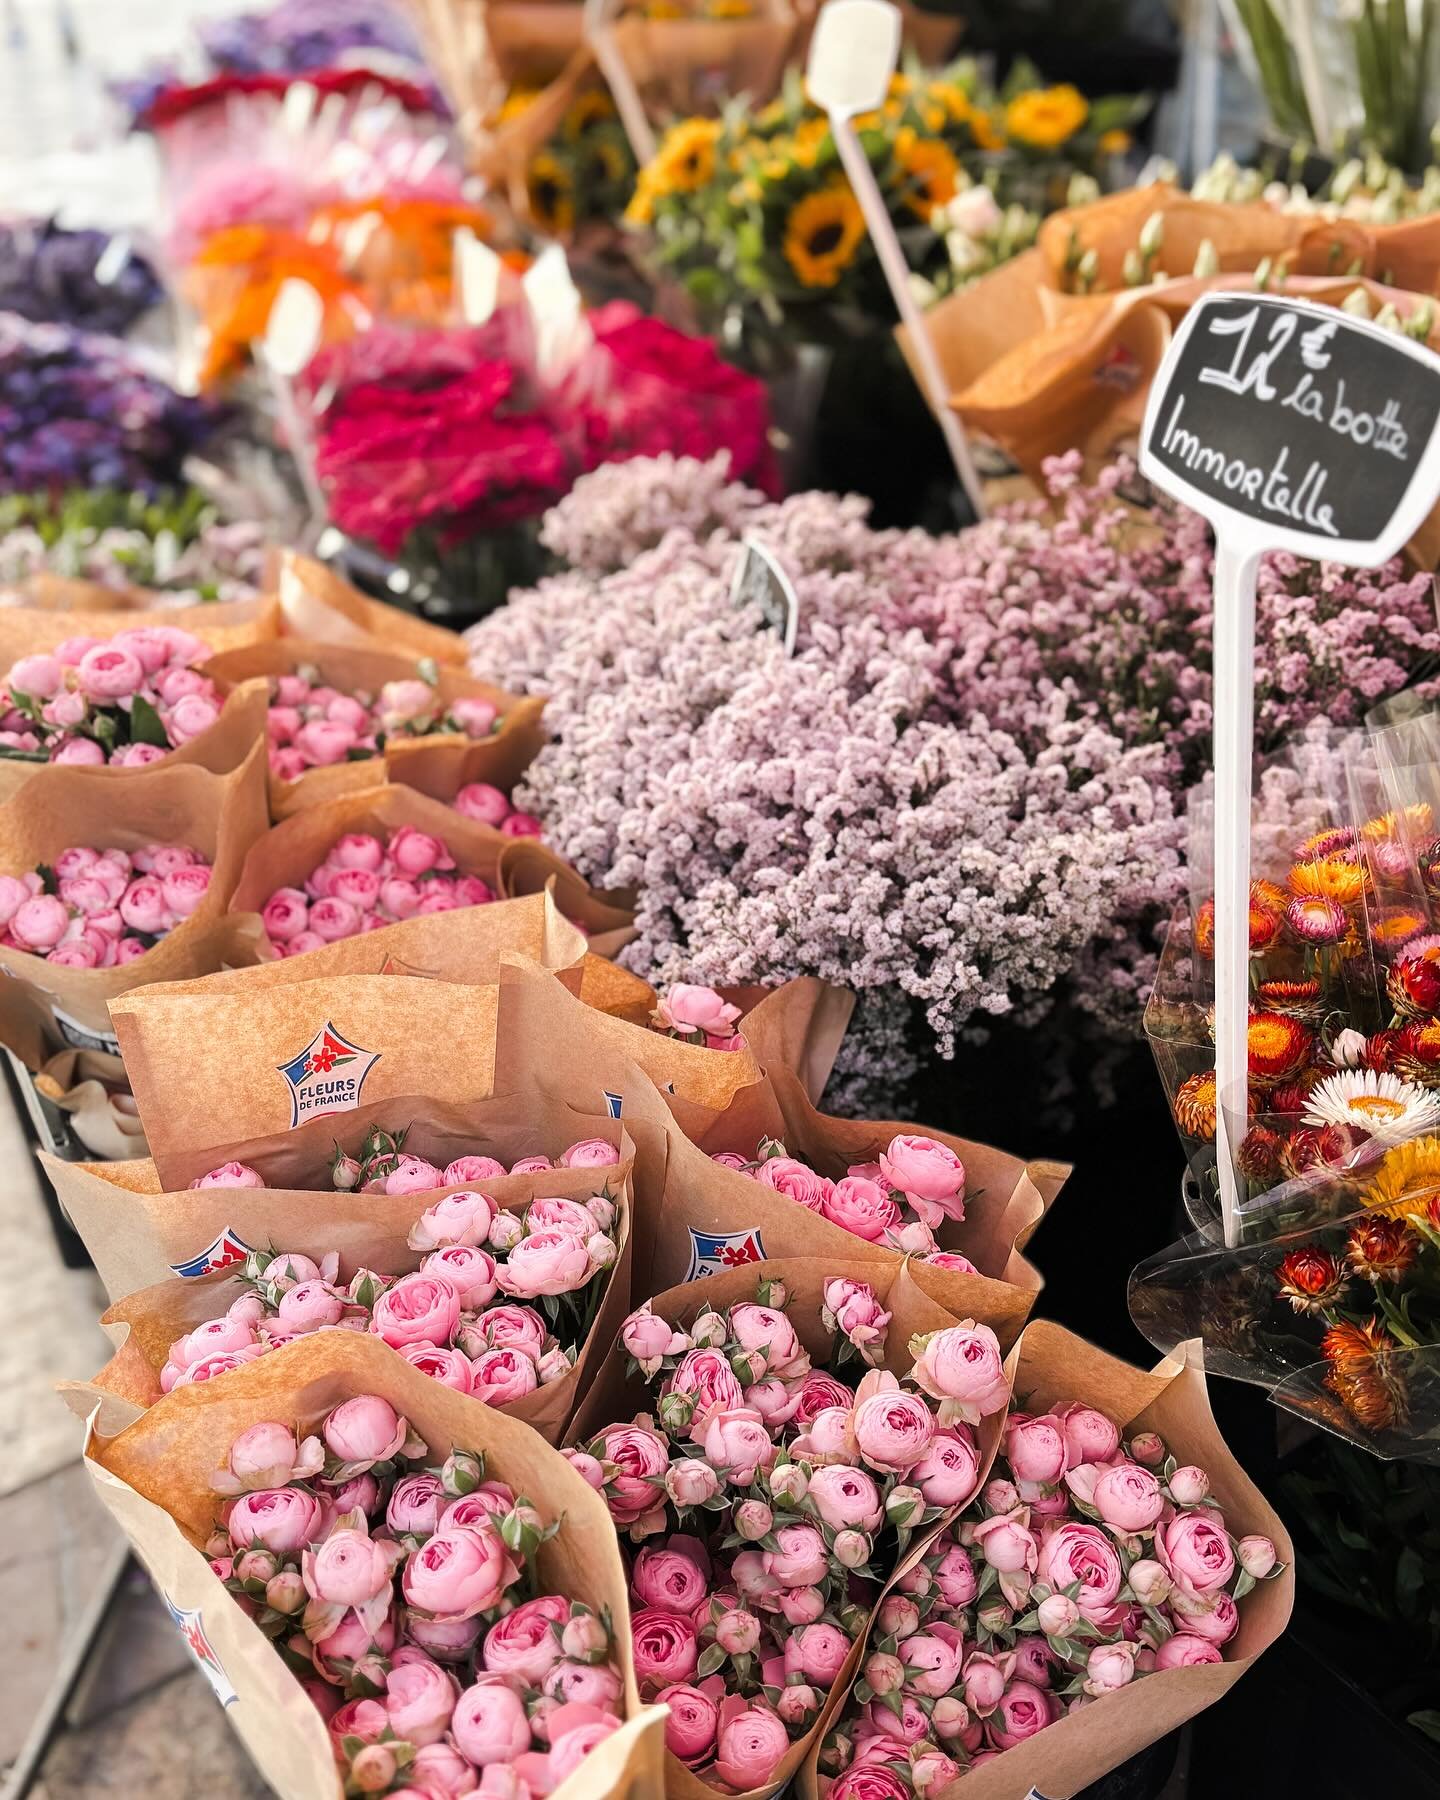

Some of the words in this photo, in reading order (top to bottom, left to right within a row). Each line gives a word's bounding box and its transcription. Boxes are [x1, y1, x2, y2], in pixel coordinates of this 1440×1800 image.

[1281, 373, 1323, 422] la
[1329, 379, 1408, 460] botte
[299, 1078, 356, 1100] FLEURS
[299, 1101, 312, 1111] DE
[314, 1092, 356, 1106] FRANCE
